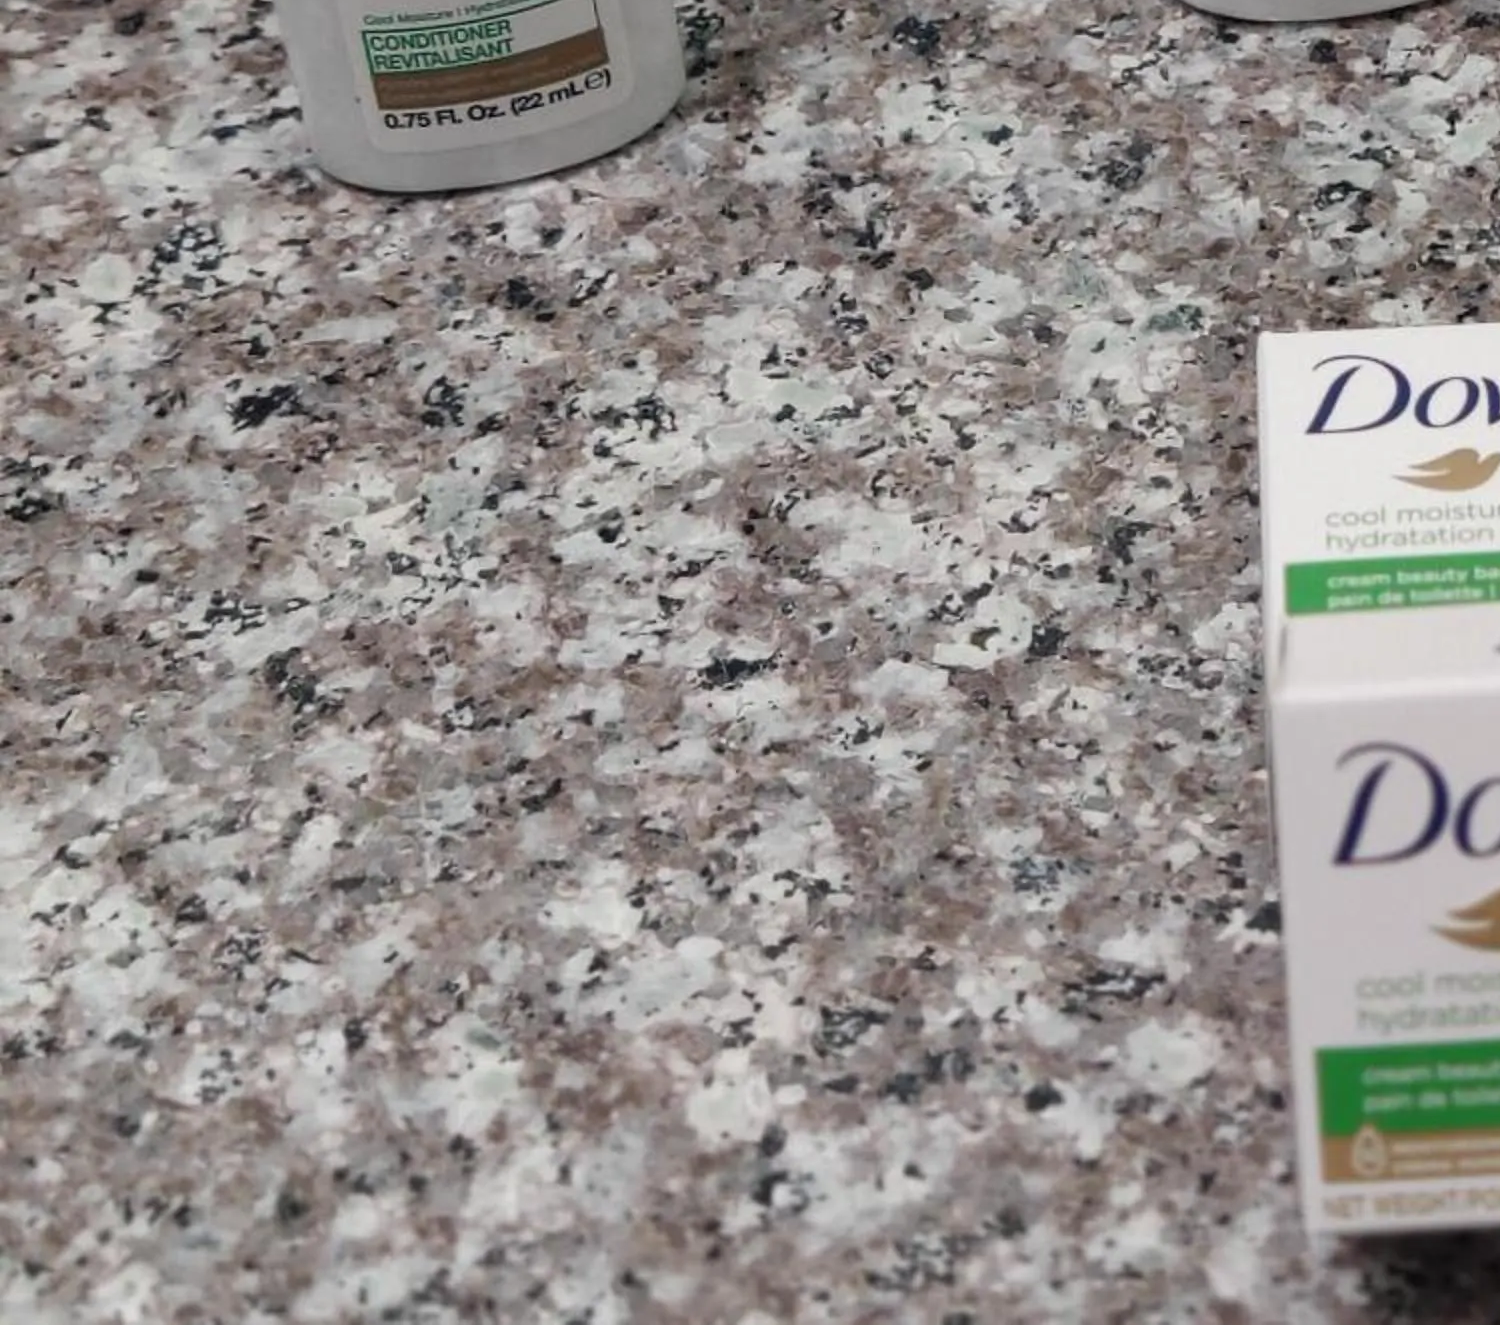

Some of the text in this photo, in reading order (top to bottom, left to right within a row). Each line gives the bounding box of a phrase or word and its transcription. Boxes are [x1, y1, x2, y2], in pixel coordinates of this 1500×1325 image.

[369, 19, 512, 52] CONDITIONER
[374, 38, 514, 71] REVITALISANT
[384, 112, 431, 130] 0.75
[436, 109, 462, 126] Fl.
[468, 105, 505, 122] Oz.
[511, 92, 545, 116] (22
[1325, 506, 1386, 527] cool
[1326, 525, 1494, 552] hydratation
[1327, 573, 1391, 590] cream
[1397, 566, 1468, 585] beauty
[1327, 592, 1372, 611] pain
[1377, 590, 1404, 606] de
[1356, 972, 1423, 999] cool
